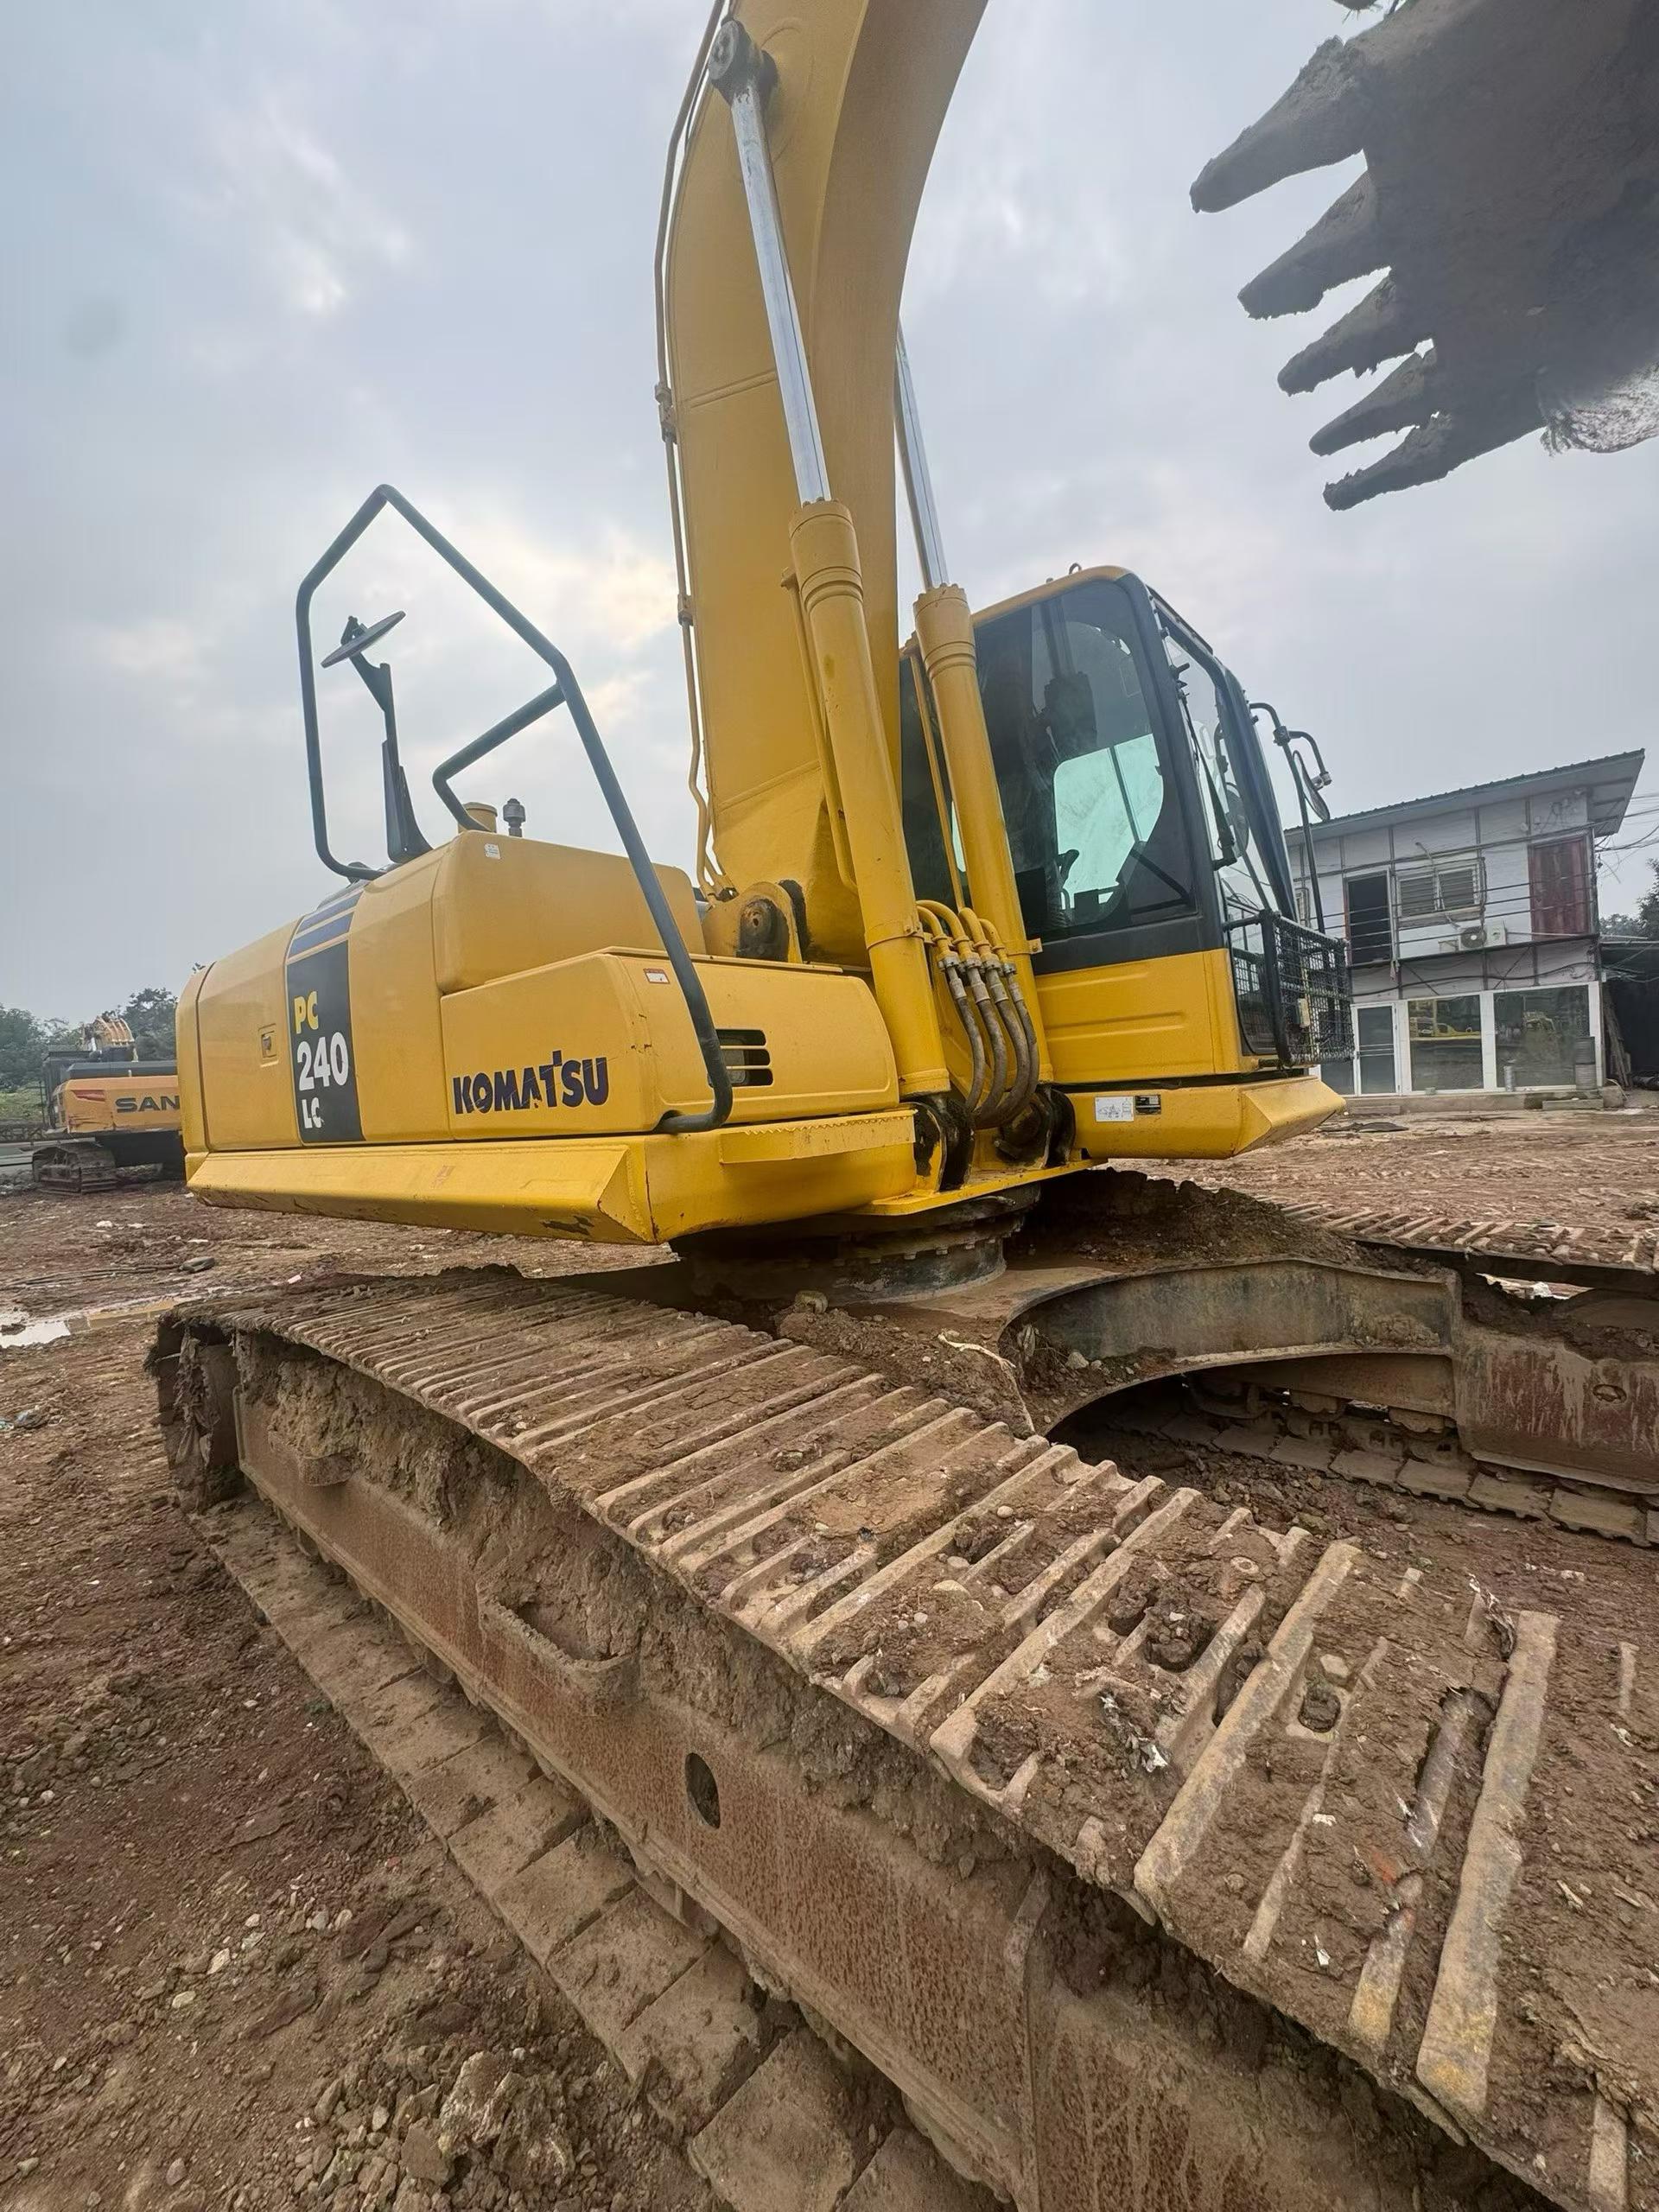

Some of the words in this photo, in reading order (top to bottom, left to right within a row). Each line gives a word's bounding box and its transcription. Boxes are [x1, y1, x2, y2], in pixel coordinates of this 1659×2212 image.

[294, 991, 319, 1034] PC
[297, 1032, 349, 1090] 240
[453, 1050, 609, 1115] KOMATSU
[302, 1097, 324, 1128] LC
